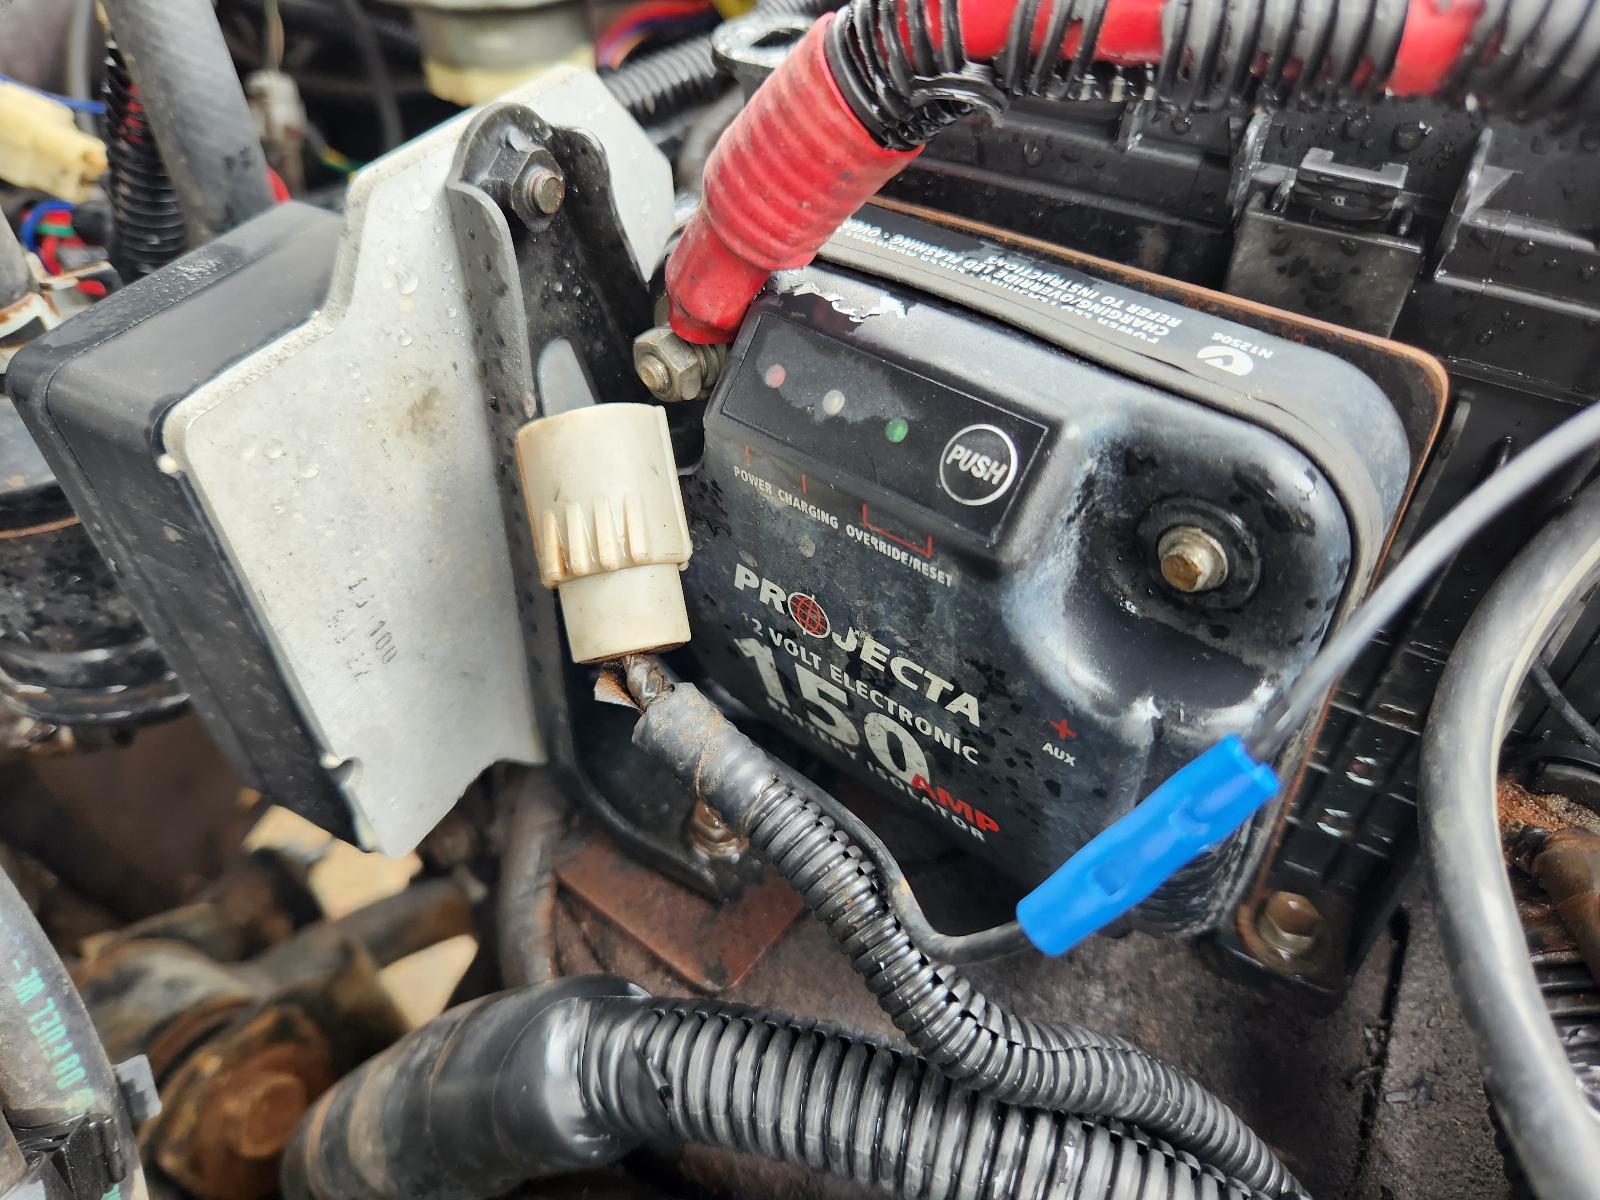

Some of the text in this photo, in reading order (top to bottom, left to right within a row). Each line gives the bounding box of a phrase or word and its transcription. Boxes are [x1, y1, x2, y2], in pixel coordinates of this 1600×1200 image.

[984, 254, 1183, 328] REFER TO INSTRUCTIONS
[1211, 332, 1274, 359] N12506
[945, 443, 1008, 486] PUSH
[733, 465, 954, 588] POWER CHARGING OVERRIDE/RESET
[734, 563, 981, 728] PROJECTA
[734, 637, 1000, 833] 150 AMP
[768, 627, 822, 671] VOLT
[830, 664, 980, 766] ELECTRONIC
[1042, 742, 1076, 767] AUX
[867, 761, 985, 842] ISOLATOR
